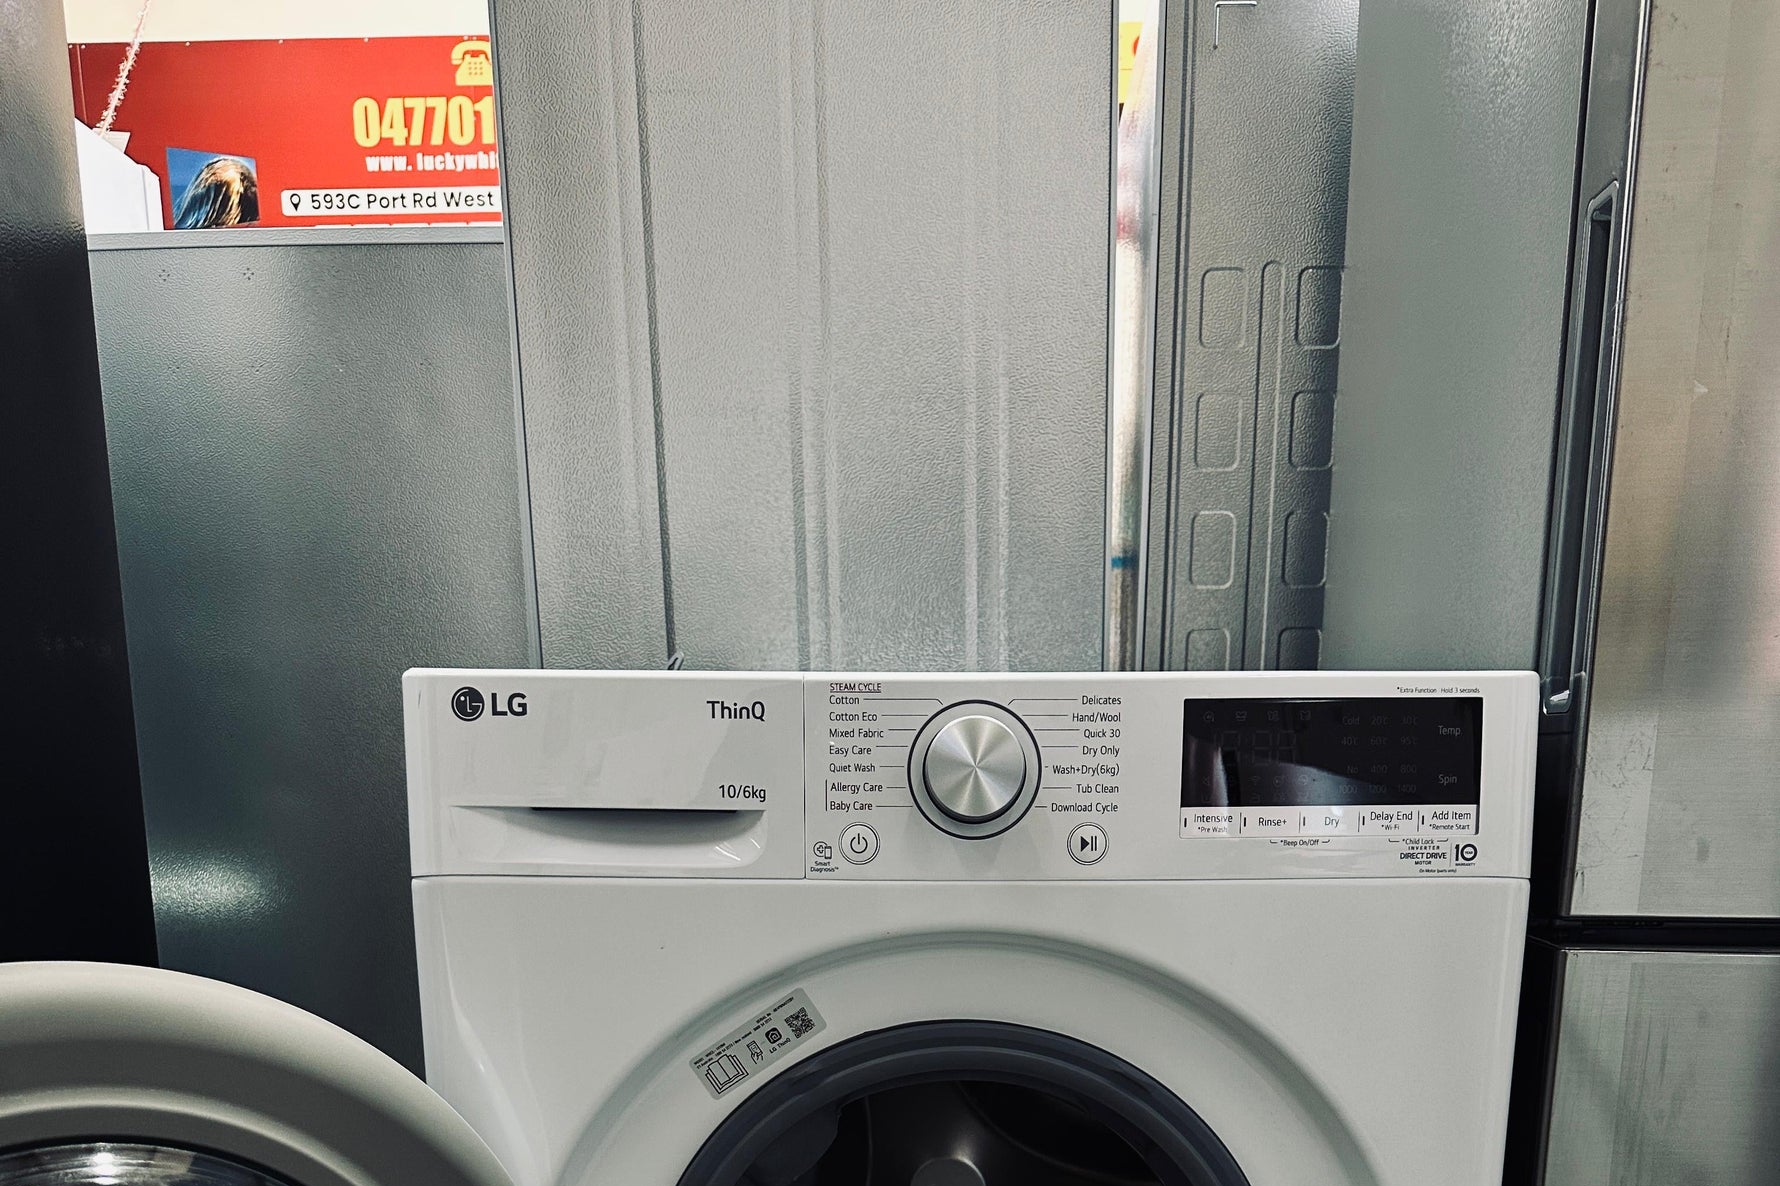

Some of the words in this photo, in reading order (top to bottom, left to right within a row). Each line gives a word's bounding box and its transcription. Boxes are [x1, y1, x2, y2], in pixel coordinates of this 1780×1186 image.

[311, 193, 360, 210] 593C
[367, 193, 407, 209] Port
[413, 192, 437, 208] Rd
[443, 191, 494, 208] West
[829, 682, 856, 691] STEAM
[857, 682, 882, 691] CYCLE
[1415, 686, 1438, 694] Function
[1440, 686, 1454, 694] Hold
[491, 693, 528, 717] LG
[829, 694, 860, 705] Cotton
[1081, 695, 1122, 705] Delicates
[707, 700, 766, 721] ThinQ
[829, 711, 860, 722] Cotton
[862, 711, 878, 722] Eco
[1072, 711, 1121, 723] Hand/Wool
[829, 728, 855, 738] Mixed
[858, 728, 885, 738] Fabric
[1083, 728, 1107, 740] Quick
[1109, 728, 1121, 738] 30
[829, 745, 849, 757] Easy
[851, 745, 872, 755] Care
[1082, 745, 1098, 758] Dry
[1100, 745, 1120, 758] Only
[829, 763, 852, 773] Quiet
[853, 763, 876, 772] Wash
[1052, 763, 1120, 776] Wash+Dry(6kg)
[1438, 774, 1458, 787] Spin
[718, 784, 766, 802] 10/6kg
[830, 782, 861, 794] Allergy
[862, 782, 883, 792] Care
[1076, 783, 1093, 793] Tub
[1094, 783, 1119, 793] Clean
[830, 800, 851, 812] Baby
[852, 800, 873, 811] Care
[1051, 802, 1093, 812] Download
[1095, 802, 1119, 814] Cycle
[1194, 813, 1233, 823] Intensive
[1370, 811, 1394, 822] Delay
[1396, 810, 1413, 821] End
[1431, 811, 1449, 820] Add
[1451, 811, 1472, 820] Item
[1258, 817, 1287, 827] Rinse+
[1324, 816, 1340, 828] Dry
[1455, 823, 1470, 831] Start
[1298, 838, 1319, 847] On/Off
[1400, 852, 1424, 860] DIRECT
[1426, 852, 1447, 860] DRIVE
[1455, 843, 1478, 862] 10
